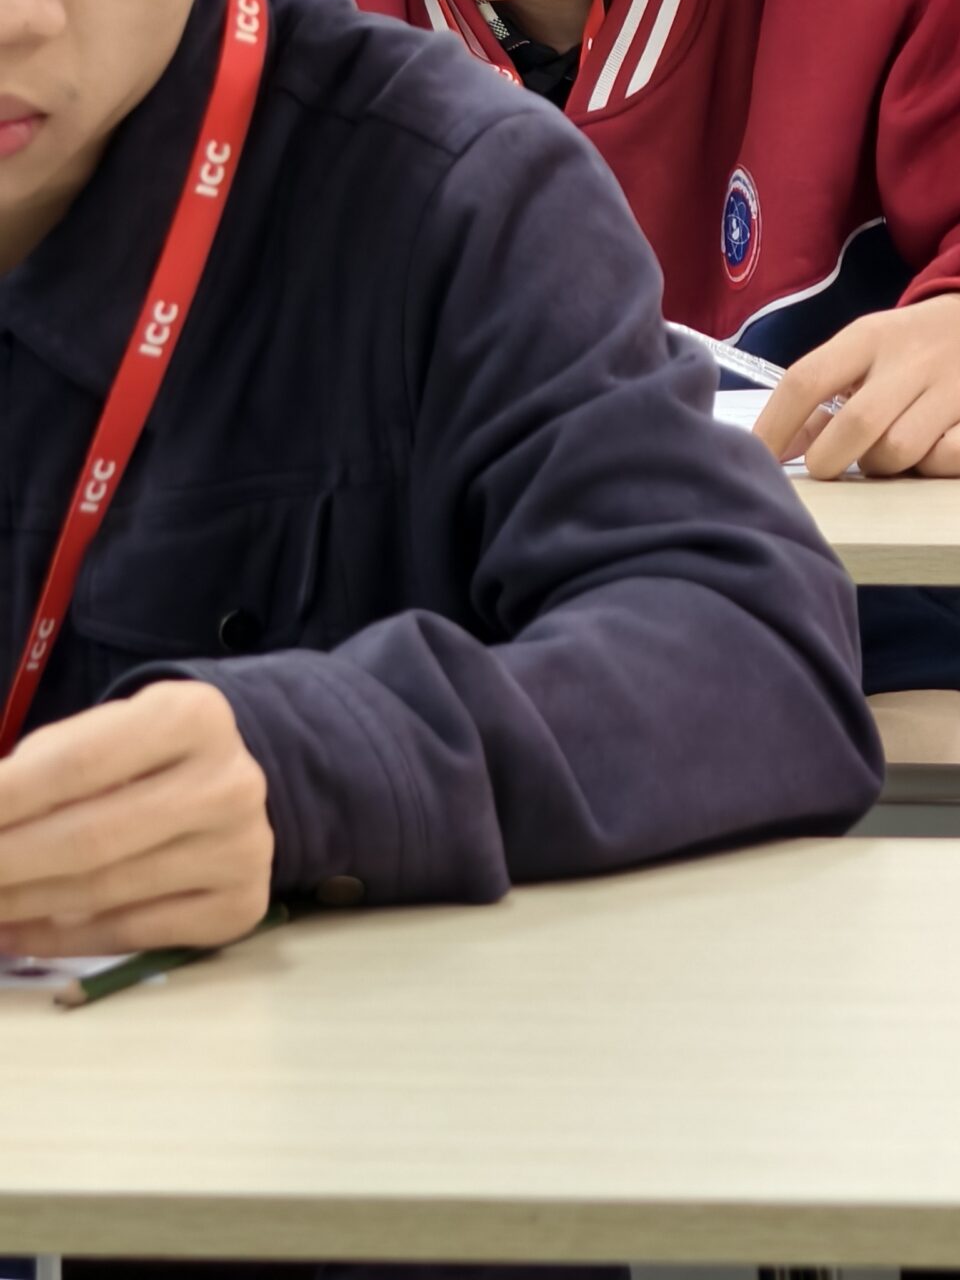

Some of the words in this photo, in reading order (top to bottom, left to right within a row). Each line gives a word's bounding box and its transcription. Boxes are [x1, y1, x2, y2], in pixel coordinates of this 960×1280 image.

[195, 140, 231, 198] ICC
[139, 300, 179, 357] ICC
[80, 458, 116, 513] ICC
[26, 617, 55, 671] ICC
